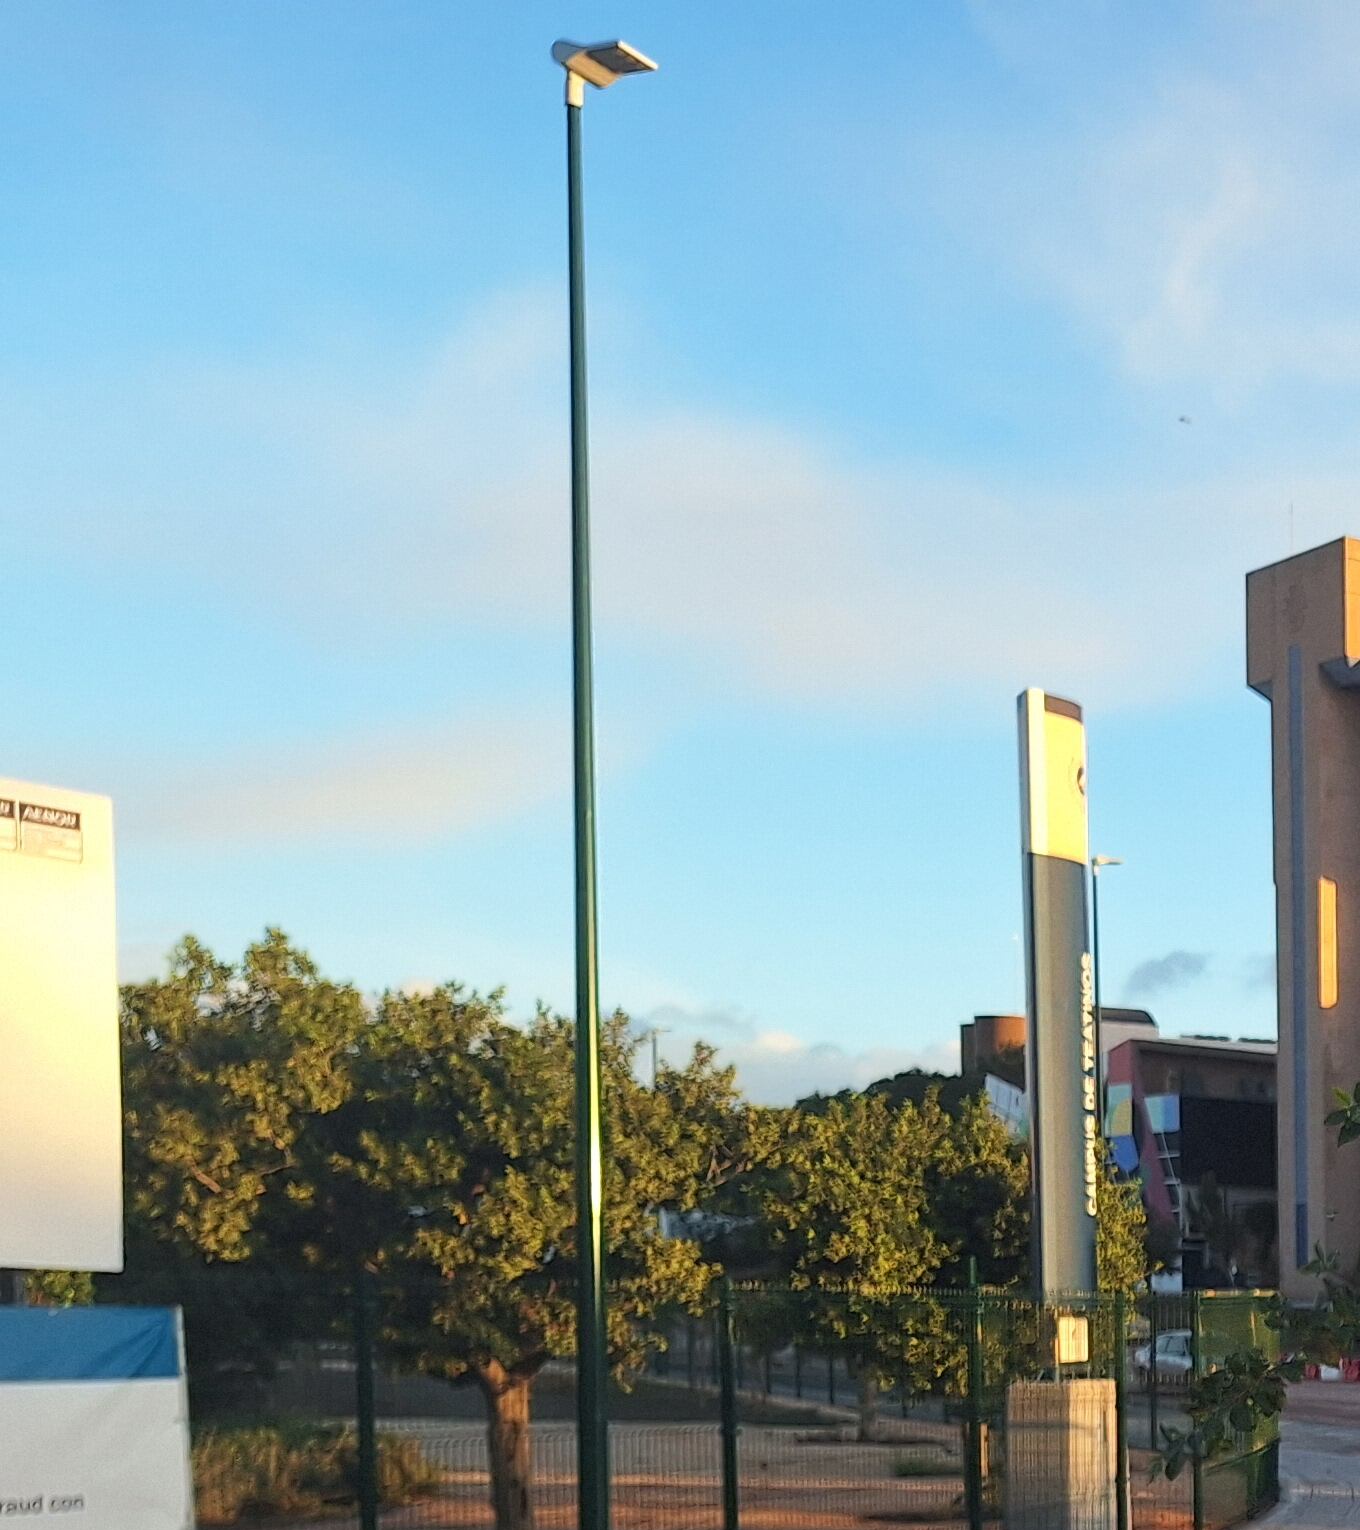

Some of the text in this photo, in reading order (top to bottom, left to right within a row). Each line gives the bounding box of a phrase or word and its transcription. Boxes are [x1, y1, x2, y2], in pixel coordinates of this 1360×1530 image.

[1080, 951, 1098, 1217] CAMPUS DE TEATINOS
